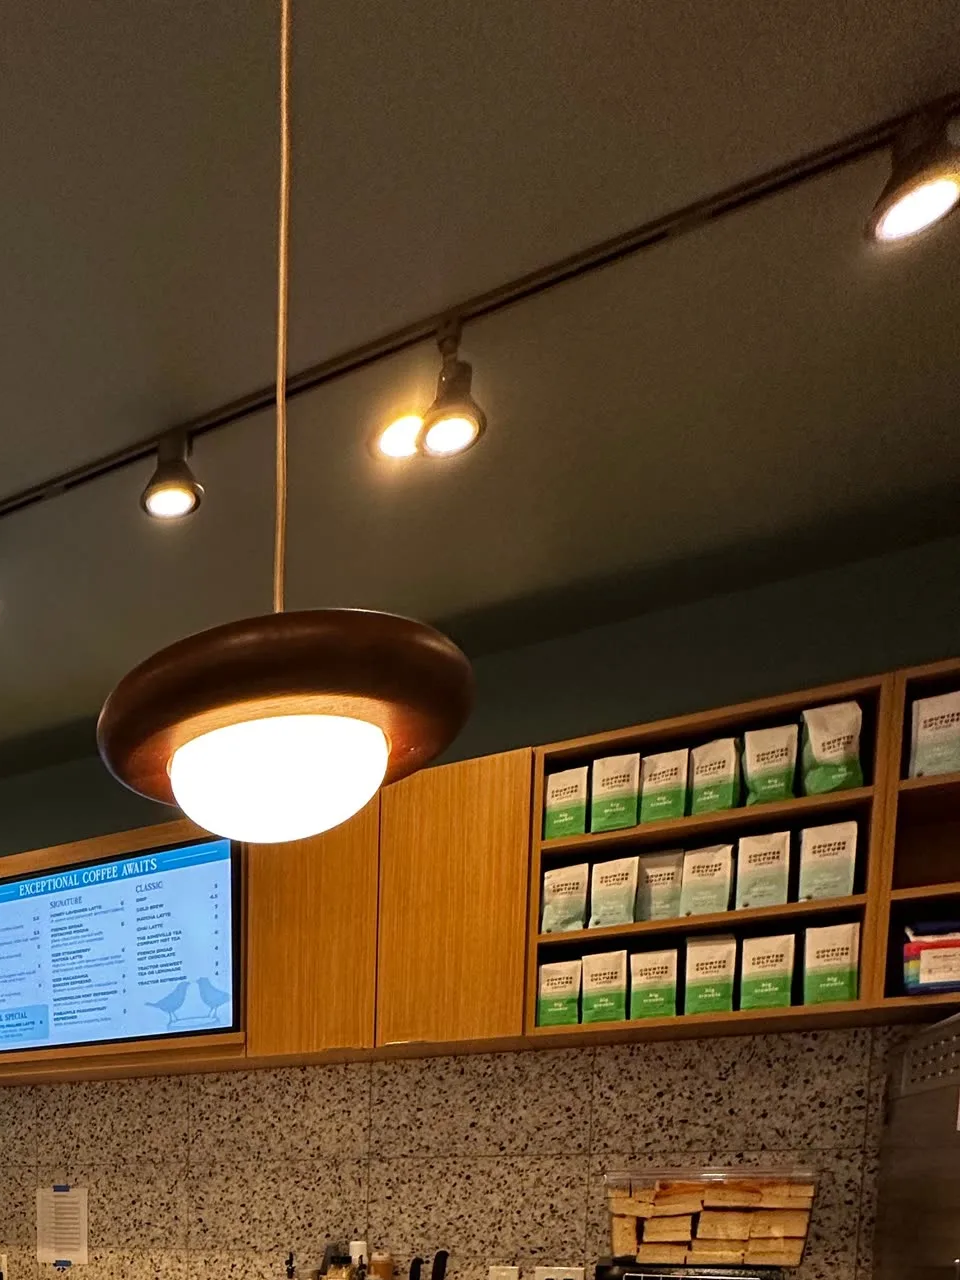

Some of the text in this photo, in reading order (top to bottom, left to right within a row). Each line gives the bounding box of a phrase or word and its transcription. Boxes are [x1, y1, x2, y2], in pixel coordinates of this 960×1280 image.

[20, 858, 157, 896] EXCEPTIONAL COFFEE AWAITS
[136, 881, 163, 893] CLASSIC
[50, 897, 82, 908] SIGNATURE
[5, 1011, 27, 1020] SPECIAL
